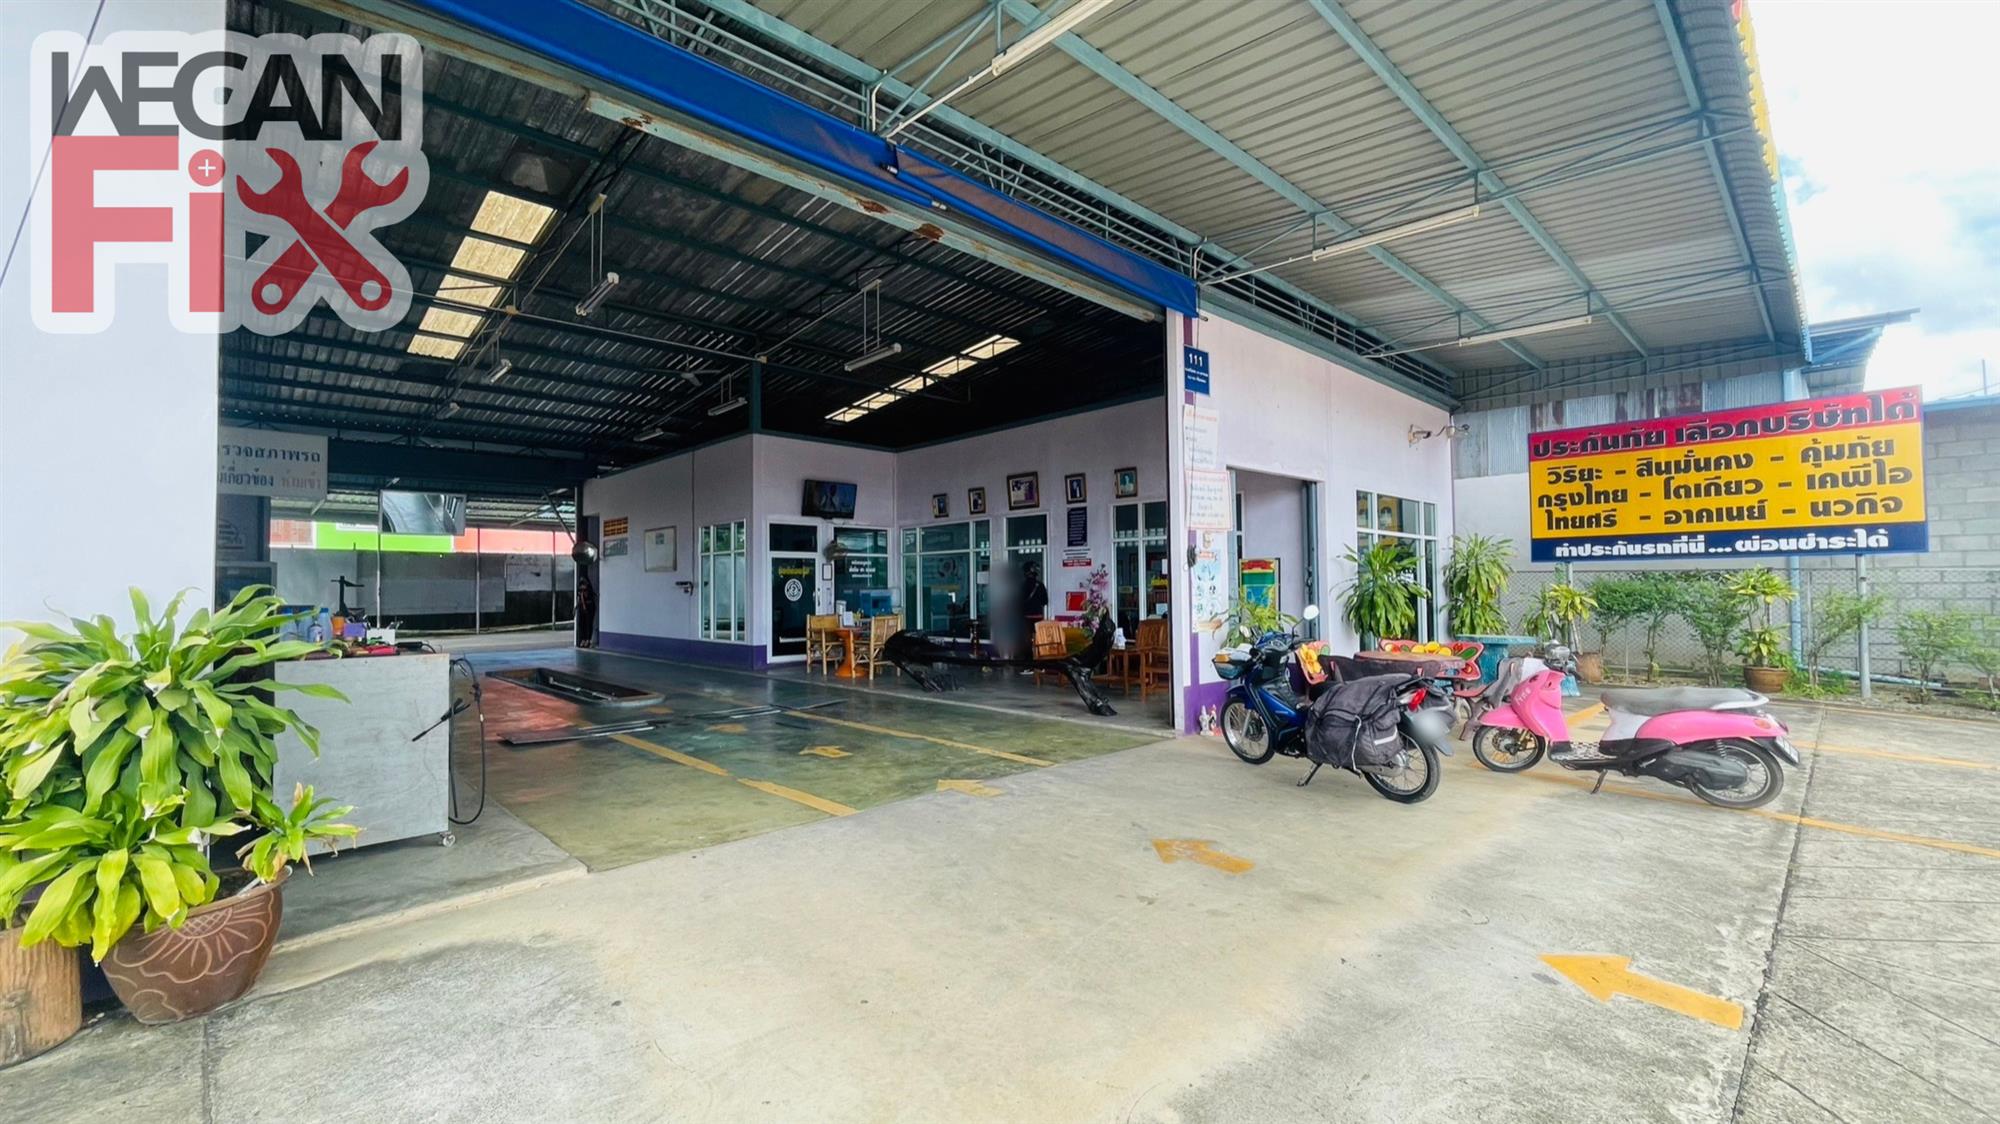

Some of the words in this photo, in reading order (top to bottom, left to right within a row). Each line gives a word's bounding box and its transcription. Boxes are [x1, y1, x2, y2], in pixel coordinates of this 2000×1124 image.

[1189, 353, 1203, 367] 111
[1533, 427, 1666, 458] ประกันภัย
[1675, 391, 1917, 444] เลือกบริษัทได้
[217, 444, 321, 463] รวจสภาพรถ
[1547, 464, 1603, 485] วิริยะ
[1636, 449, 1754, 478] สินมั่นคง
[1801, 435, 1895, 469] คุ้มภัย
[1538, 483, 1628, 512] กรุงไทย
[1664, 475, 1764, 501] โตเกียว
[1807, 459, 1913, 491] เคพีไอ
[1545, 508, 1618, 531] ไทยศรี
[1664, 499, 1768, 525] อาคเนย์
[1810, 492, 1904, 518] นวกิจ
